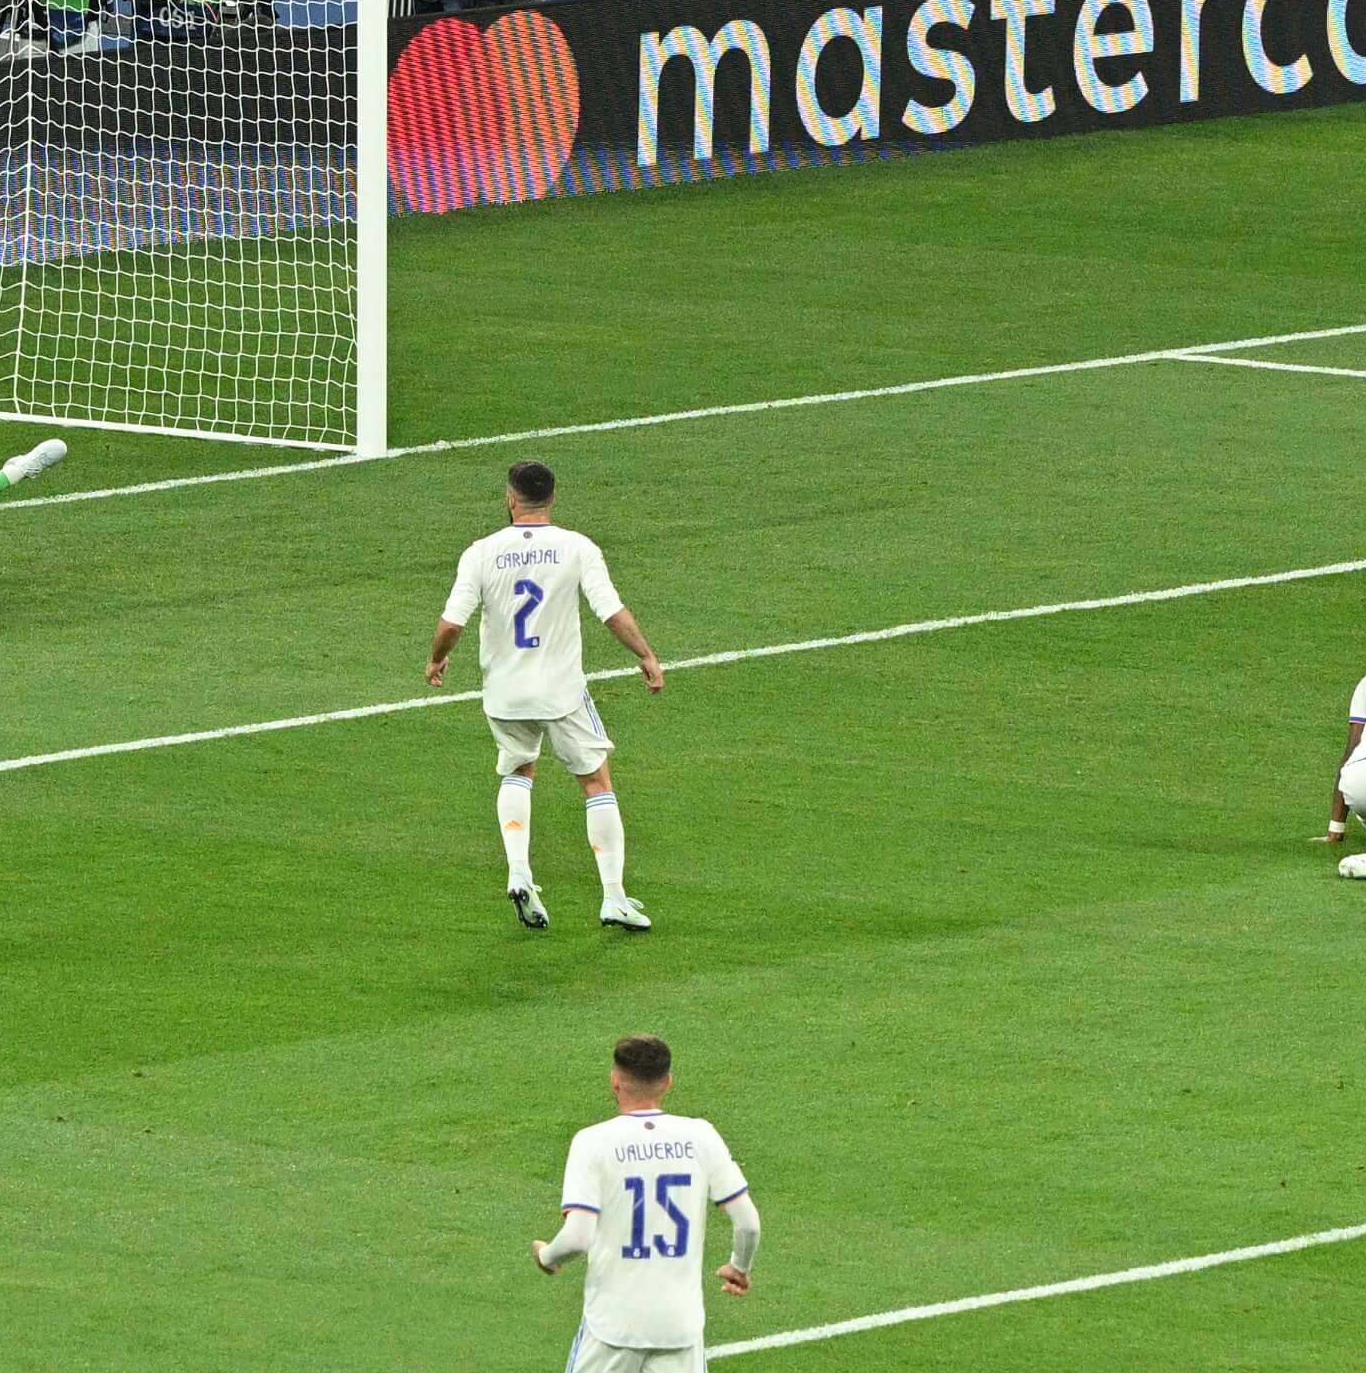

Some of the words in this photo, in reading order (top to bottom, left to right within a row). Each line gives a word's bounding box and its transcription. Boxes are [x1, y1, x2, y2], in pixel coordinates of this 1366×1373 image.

[496, 548, 560, 570] CARVAJAL
[513, 578, 544, 649] 2
[614, 1140, 695, 1163] VALVERDE
[621, 1173, 693, 1260] 15
